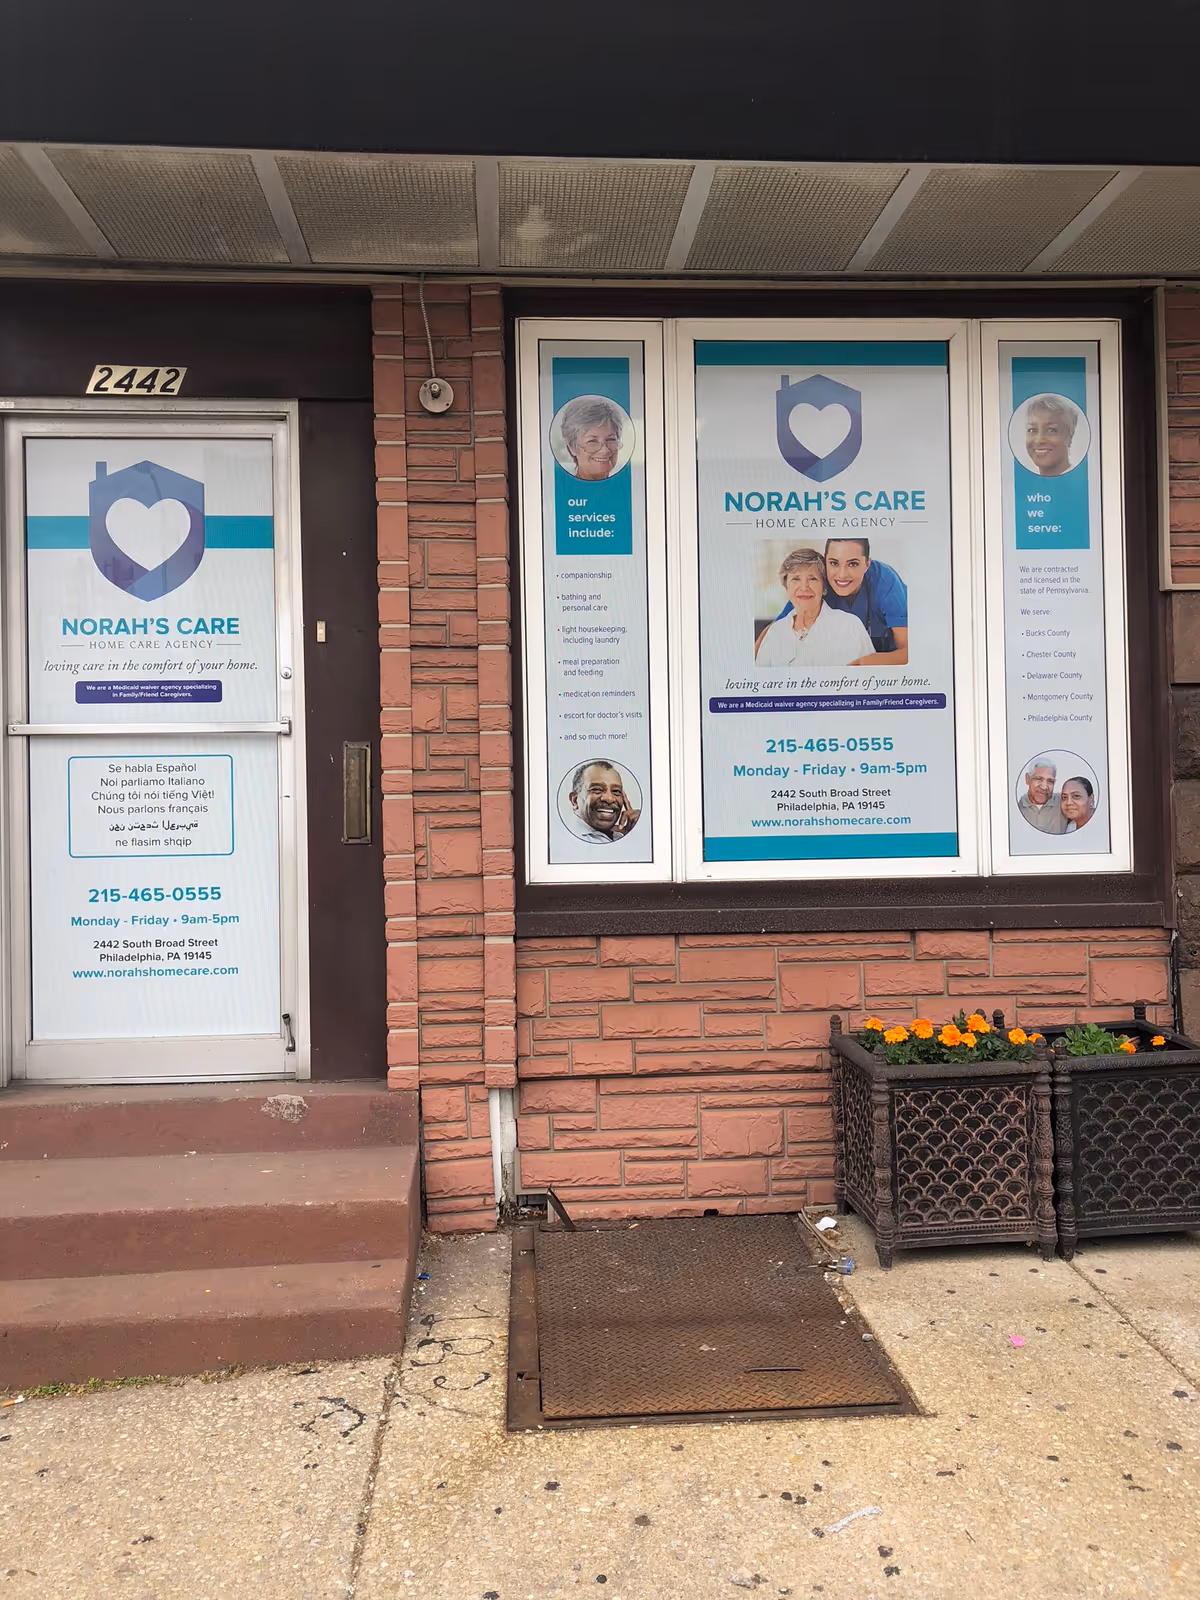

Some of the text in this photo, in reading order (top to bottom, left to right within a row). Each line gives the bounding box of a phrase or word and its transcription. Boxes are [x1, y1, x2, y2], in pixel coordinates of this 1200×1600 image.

[93, 367, 181, 392] 2442
[568, 498, 587, 507] our
[725, 491, 925, 512] NORAH'S CARE
[1027, 493, 1051, 502] who
[568, 513, 616, 522] services
[1027, 509, 1044, 517] we
[756, 518, 895, 528] HOME CARE AGENCY
[568, 528, 614, 538] include:
[1028, 524, 1061, 533] serve:
[561, 571, 612, 580] companionship
[562, 593, 586, 602] bathing
[562, 604, 591, 613] personal
[63, 618, 239, 635] NORAH'S CARE
[562, 625, 576, 634] light
[90, 640, 212, 649] HOME CARE AGENCY
[563, 636, 620, 645] including laundry
[44, 660, 80, 675] loving
[108, 660, 119, 670] in
[123, 660, 139, 670] the
[142, 659, 183, 673] comfort
[186, 659, 198, 674] of
[197, 660, 224, 674] your
[227, 659, 257, 670] home.
[563, 658, 620, 666] meal preparation
[578, 669, 603, 677] feeding
[1060, 672, 1082, 680] County
[726, 679, 760, 692] loving
[787, 678, 797, 688] in
[801, 677, 816, 688] the
[820, 677, 858, 690] comfort
[862, 676, 874, 690] of
[873, 678, 898, 690] your
[901, 676, 930, 686] home.
[563, 690, 600, 698] medication
[1028, 693, 1093, 701] Montgomery County
[819, 700, 854, 708] specializing
[863, 699, 903, 707] Family/Friend
[905, 698, 939, 706] Caregivers.
[1028, 714, 1093, 722] Philadelphia County
[609, 732, 627, 740] more!
[766, 738, 893, 752] 215-465-0555
[109, 763, 196, 773] Se habla Español
[734, 765, 789, 778] Monday
[803, 764, 846, 777] Friday
[860, 762, 926, 776] 9am-5pm
[101, 777, 205, 788] Noi parliamo Italiano
[92, 790, 214, 802] Chúng tôi nói tiếng Việt!
[771, 790, 796, 798] 2442
[831, 789, 858, 797] Broad
[98, 804, 208, 815] Nous parlons français
[777, 803, 839, 812] Philadelphia,
[858, 801, 885, 809] 19145
[752, 816, 911, 827] www.norahshomecare.com
[132, 838, 160, 846] flasim
[164, 837, 191, 847] shqip
[89, 887, 221, 902] 215-465-0555
[71, 916, 120, 928] Monday
[132, 915, 169, 927] Friday
[181, 914, 239, 925] 9am-5pm
[94, 939, 218, 948] 2442 South Broad Street
[100, 952, 212, 962] Philadelphia, PA 19145
[73, 967, 238, 978] www.norahshomecare.com
